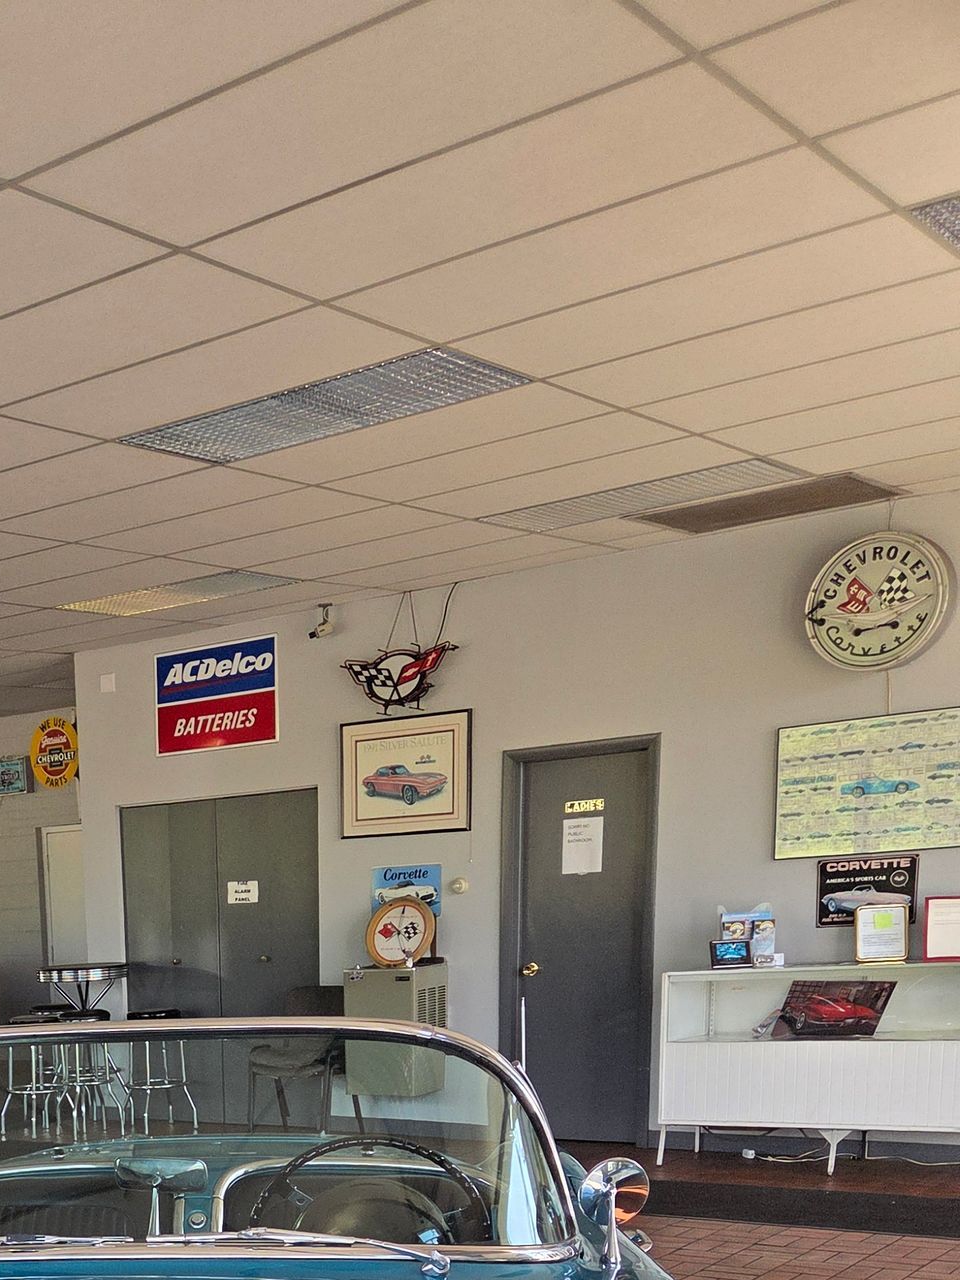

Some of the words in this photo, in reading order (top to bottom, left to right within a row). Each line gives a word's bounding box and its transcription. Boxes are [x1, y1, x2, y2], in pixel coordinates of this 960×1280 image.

[824, 546, 932, 600] CHEVROLET
[163, 651, 274, 688] ACDelco
[39, 720, 51, 733] WE
[53, 717, 66, 730] USE
[174, 708, 258, 738] BATTERIES
[37, 751, 75, 764] CHEVROLET
[44, 774, 68, 788] PARTS
[566, 800, 603, 812] LADIES
[826, 858, 912, 873] CORVETTE
[383, 868, 429, 882] Corvette
